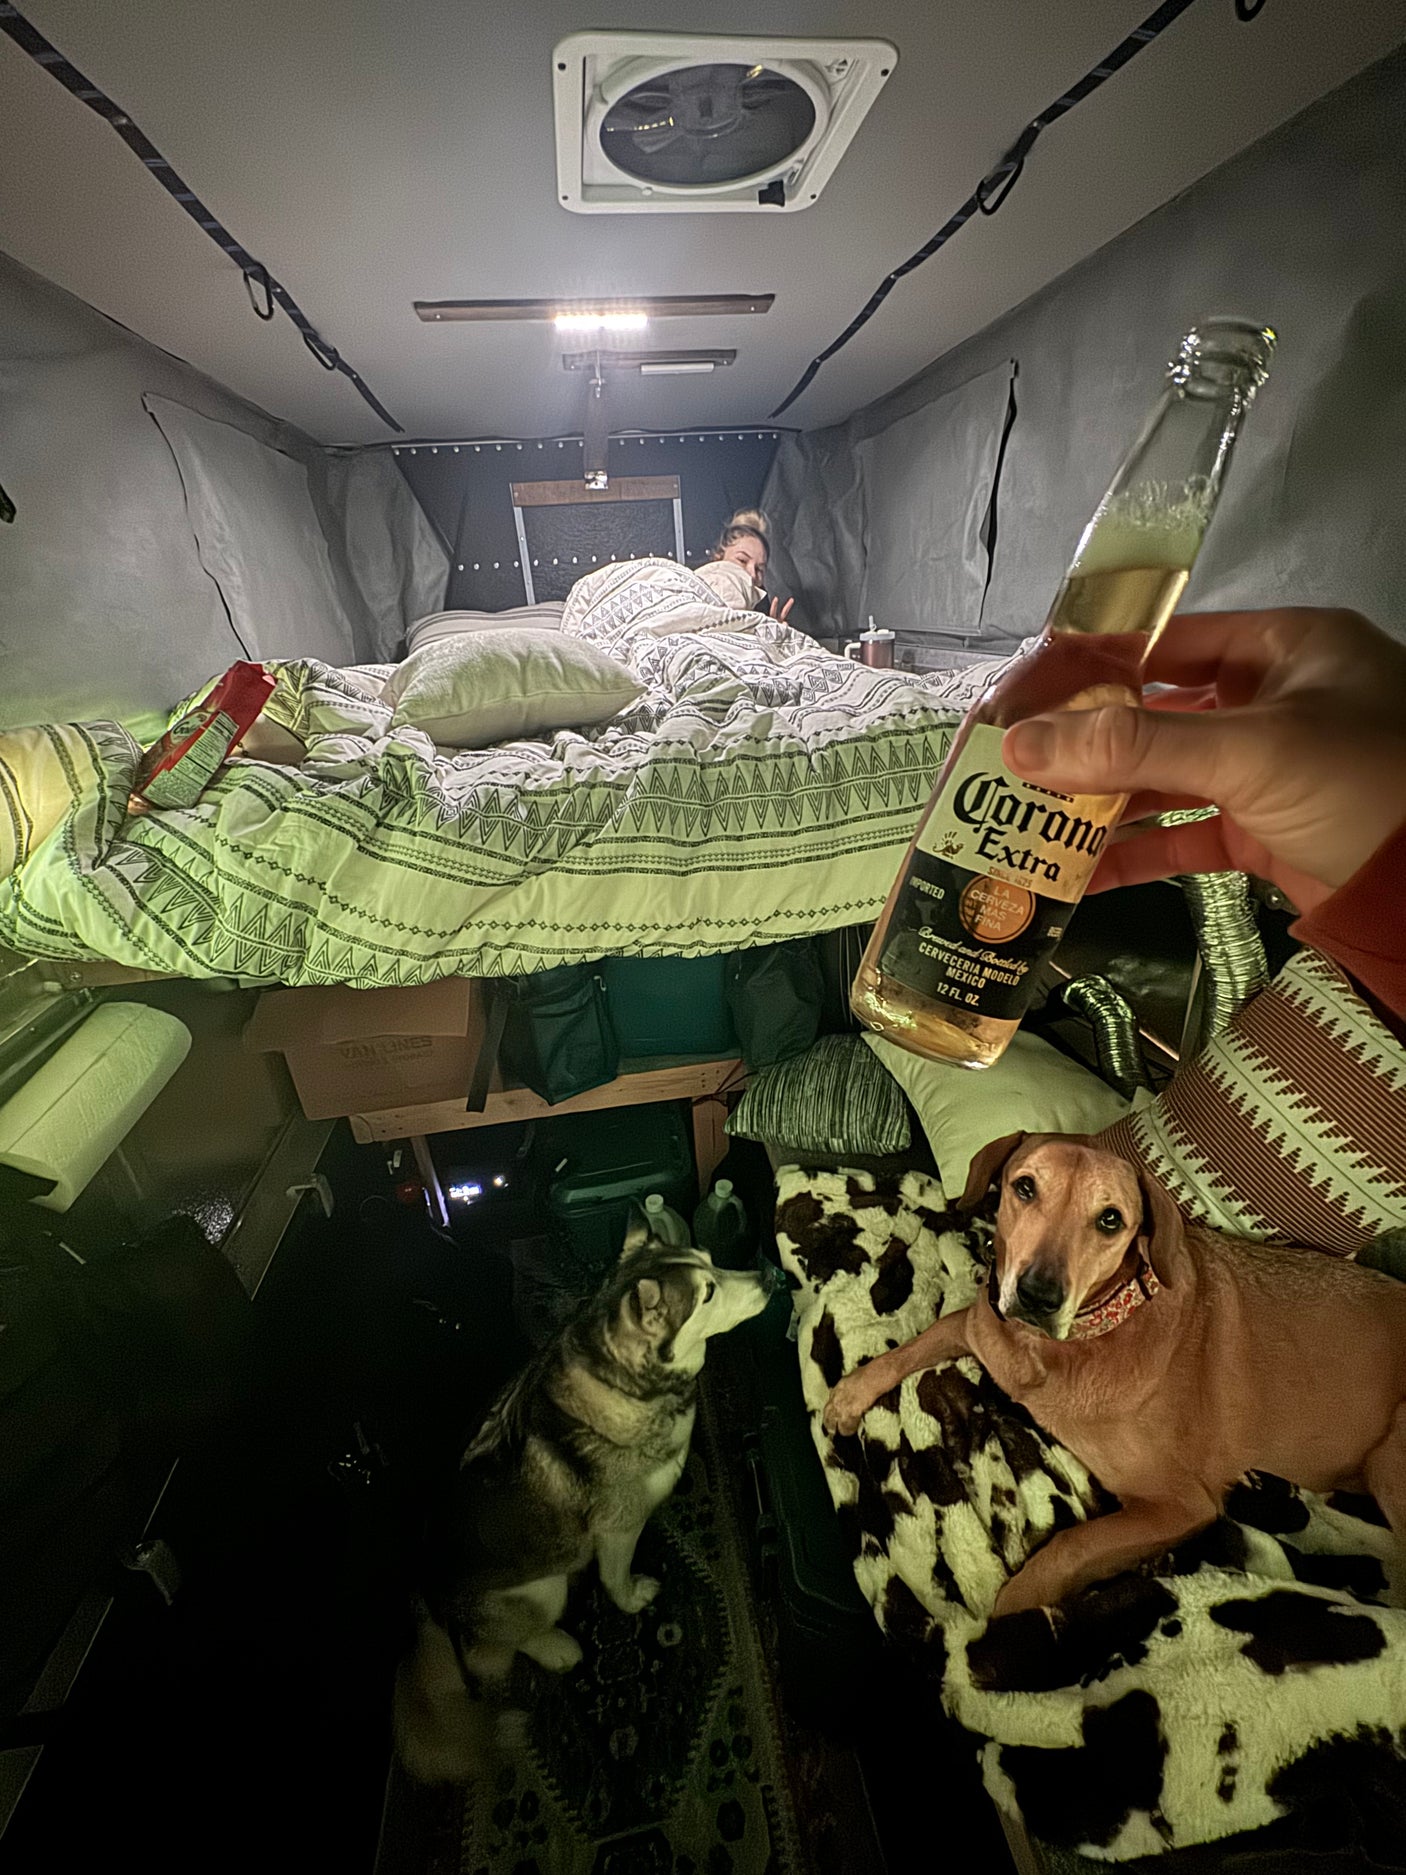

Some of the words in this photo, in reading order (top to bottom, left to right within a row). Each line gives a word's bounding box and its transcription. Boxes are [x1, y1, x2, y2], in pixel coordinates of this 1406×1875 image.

[953, 772, 1107, 857] Corona
[975, 826, 1061, 881] Extra
[970, 889, 1025, 915] CERVEZA
[993, 886, 1010, 898] LA
[974, 914, 1001, 931] FINA
[918, 942, 981, 974] CERVECERIA
[981, 967, 1021, 986] MODELO
[937, 982, 949, 995] 12
[945, 967, 986, 989] MEXICO
